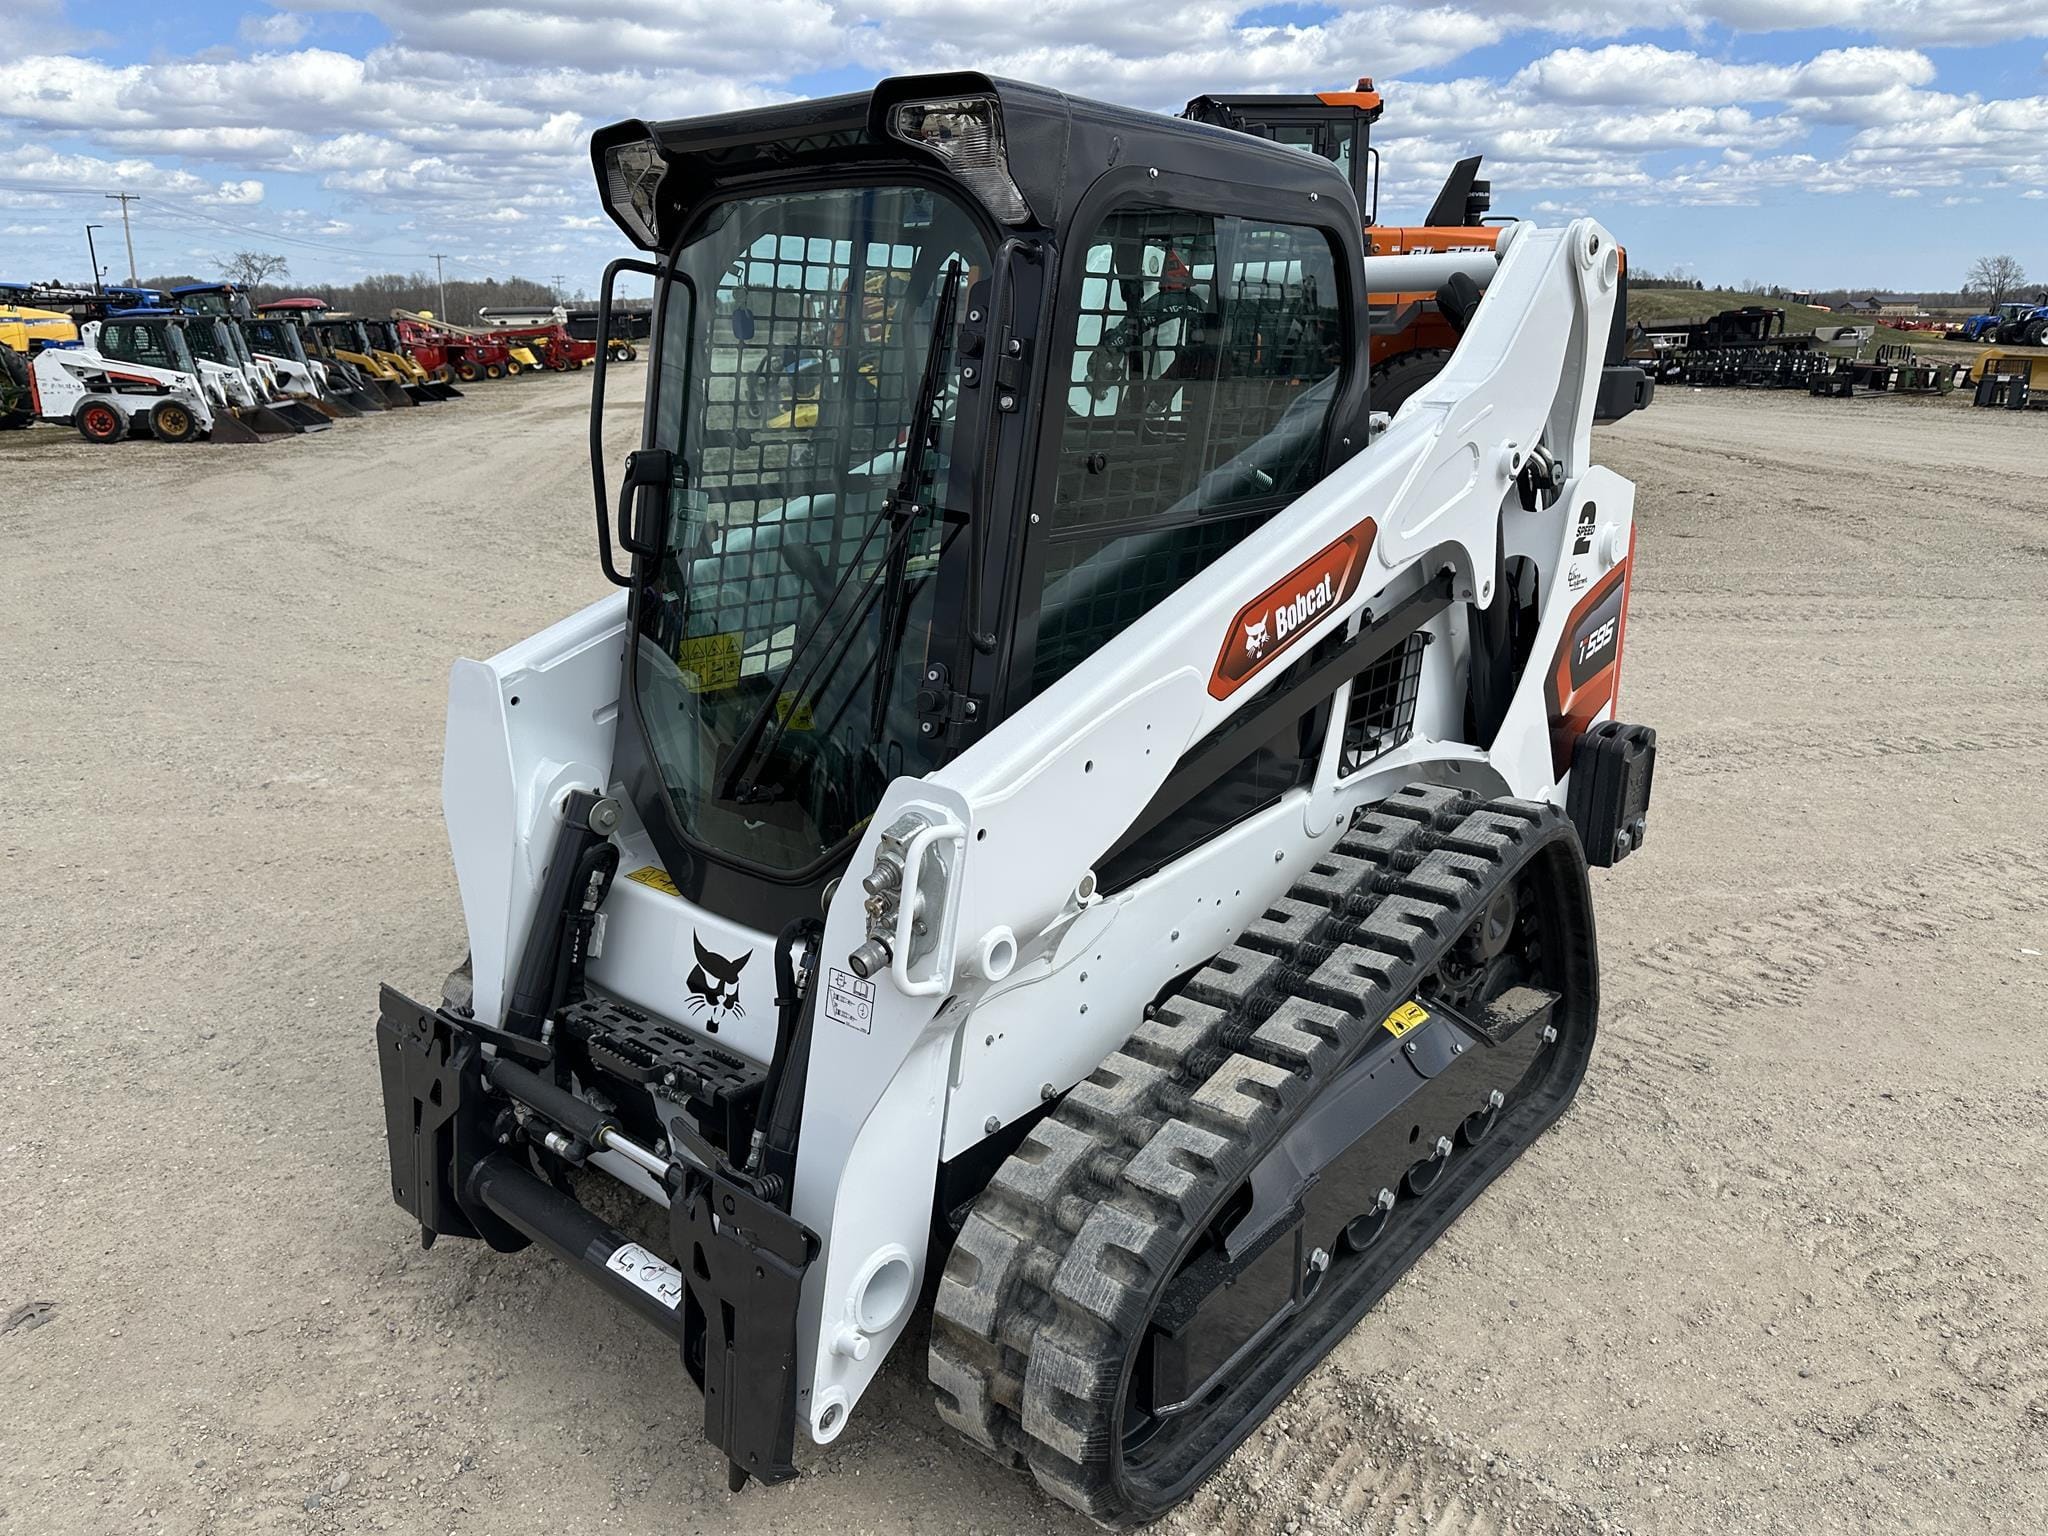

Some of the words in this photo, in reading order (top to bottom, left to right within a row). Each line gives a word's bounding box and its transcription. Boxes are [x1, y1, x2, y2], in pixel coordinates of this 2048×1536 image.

[1573, 501, 1596, 555] 2
[1576, 525, 1596, 537] SPEED
[1275, 572, 1332, 641] Bobcat
[1579, 616, 1616, 665] T595
